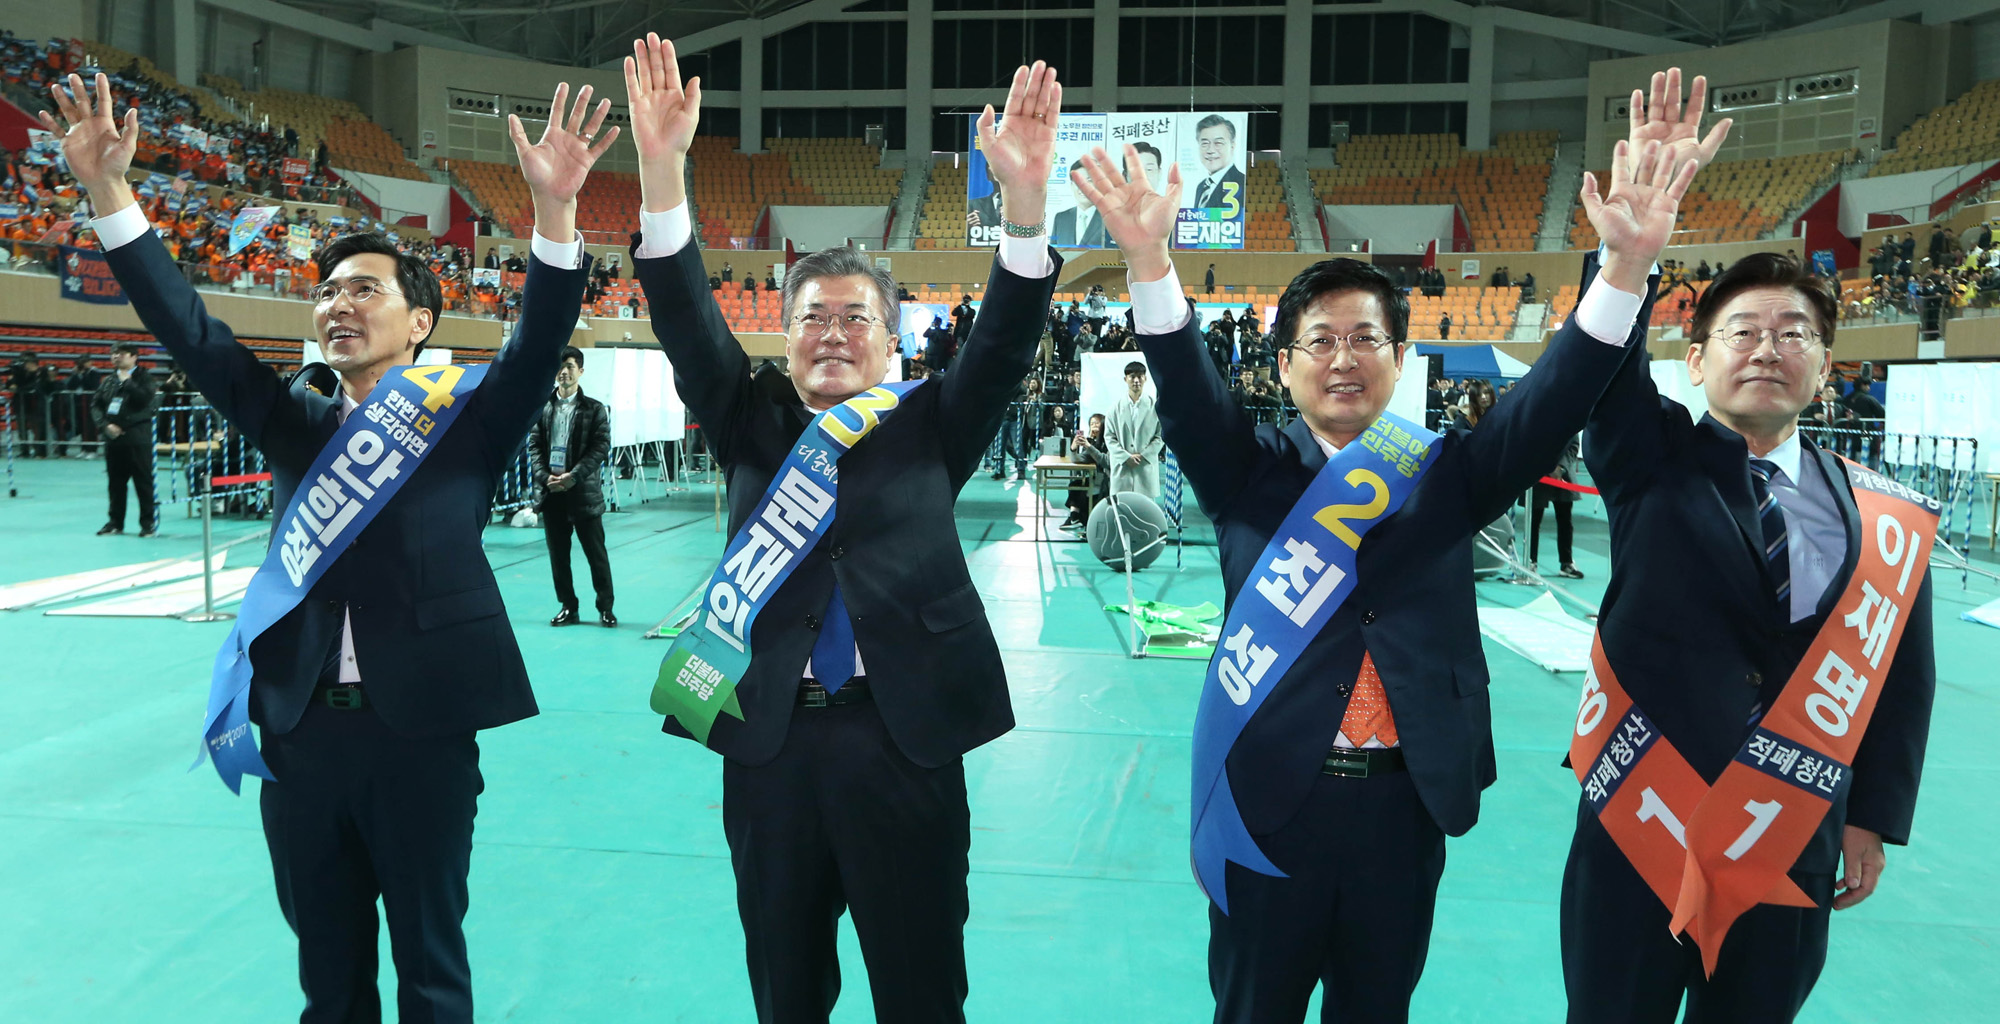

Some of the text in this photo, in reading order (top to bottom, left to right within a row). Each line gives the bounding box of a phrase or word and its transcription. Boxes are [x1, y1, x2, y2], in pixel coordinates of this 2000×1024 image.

[1081, 131, 1103, 141] 시대!
[1112, 117, 1171, 140] 적폐청산
[1178, 210, 1186, 220] 더
[1221, 181, 1240, 219] 3
[1177, 221, 1241, 244] 문재인
[622, 307, 630, 318] C
[384, 389, 436, 437] 한번 더
[401, 365, 466, 414] 4
[364, 401, 429, 458] 생각하면
[818, 386, 899, 449] 3
[1369, 416, 1430, 461] 더불어
[798, 444, 838, 485] 더 준비
[1360, 430, 1420, 478] 민주당
[281, 429, 404, 588] 안희정
[1312, 468, 1390, 551] 2
[705, 466, 836, 653] 문재인
[1804, 514, 1921, 737] 이재명
[675, 667, 714, 701] 민주당
[685, 653, 725, 687] 더불어
[1585, 713, 1652, 802] 적폐청산
[1747, 734, 1841, 794] 적폐청산
[1635, 786, 1688, 850] 1
[1723, 799, 1783, 861] 1
